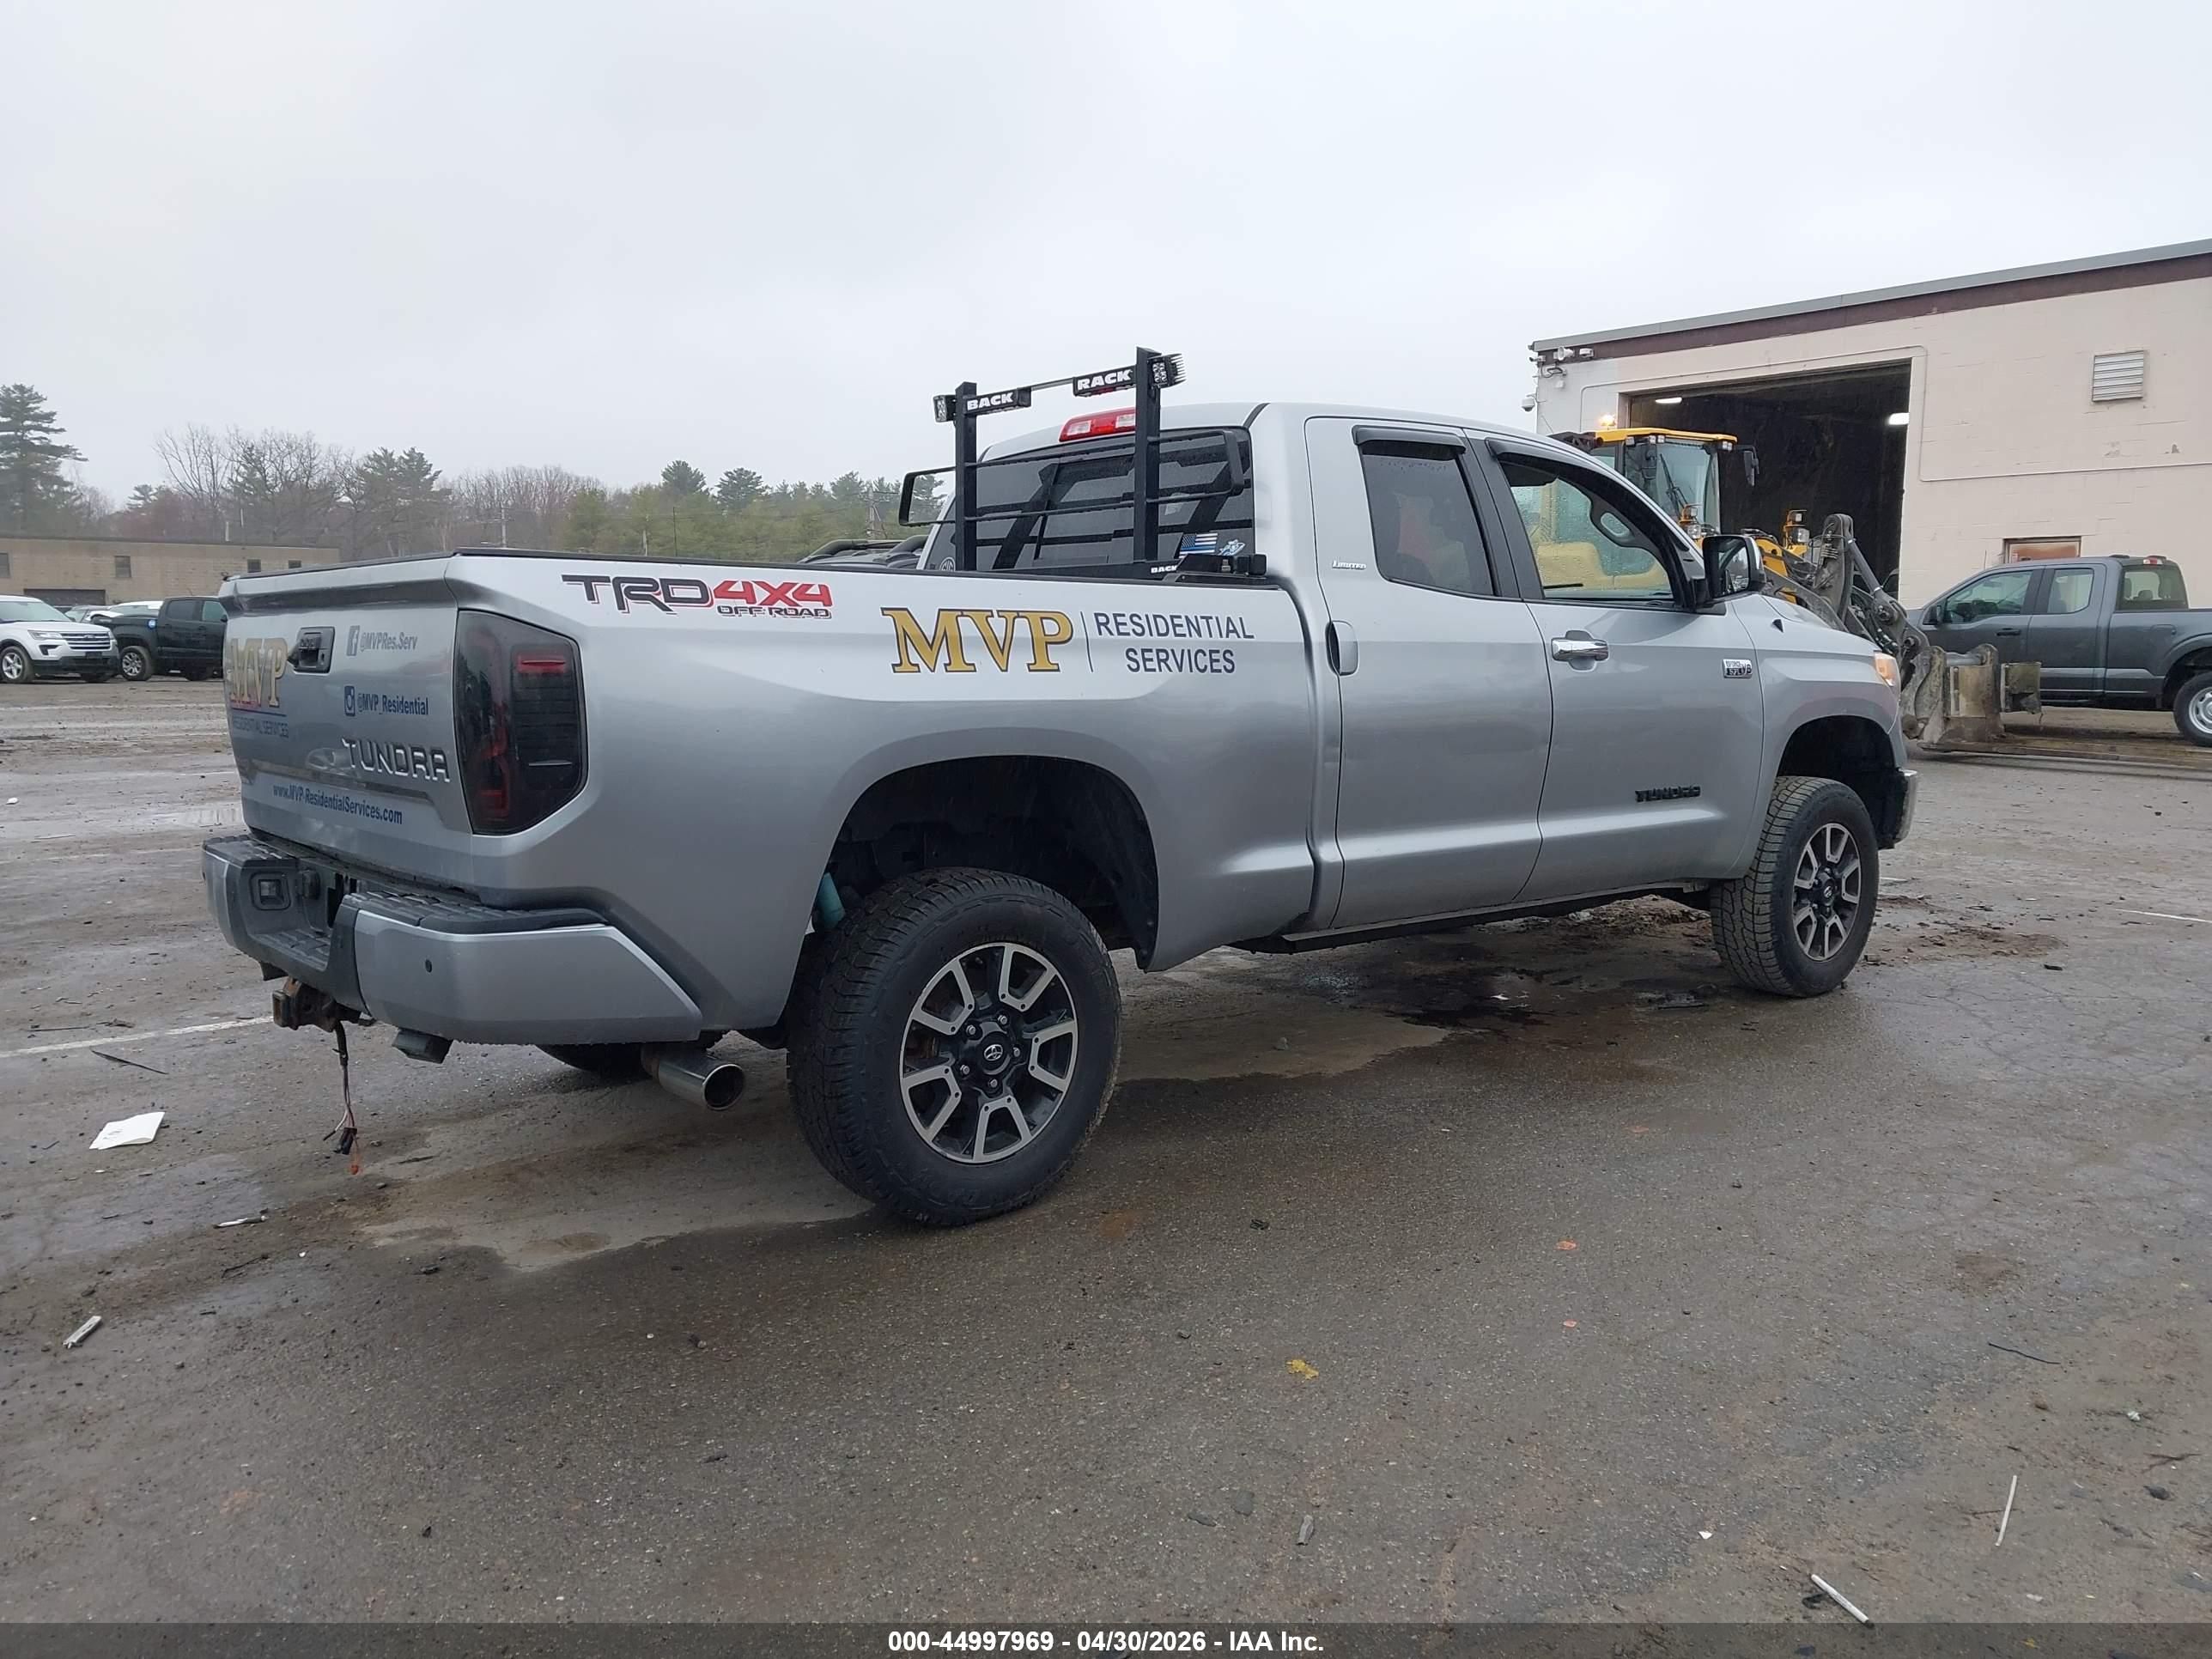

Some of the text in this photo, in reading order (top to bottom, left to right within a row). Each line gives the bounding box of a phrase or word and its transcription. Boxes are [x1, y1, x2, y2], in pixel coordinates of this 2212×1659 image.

[967, 370, 1132, 410] BACK RACK
[562, 574, 714, 614] TRD
[717, 605, 832, 619] OFF ROAD
[1095, 612, 1255, 640] RESIDENTIAL
[880, 607, 1073, 673] MVP
[228, 637, 288, 708] MVP
[1126, 647, 1236, 674] SERVICES
[357, 693, 428, 715] @MVP_Residential
[342, 738, 451, 783] TUNDRA
[1635, 786, 1700, 802] TUNDRA
